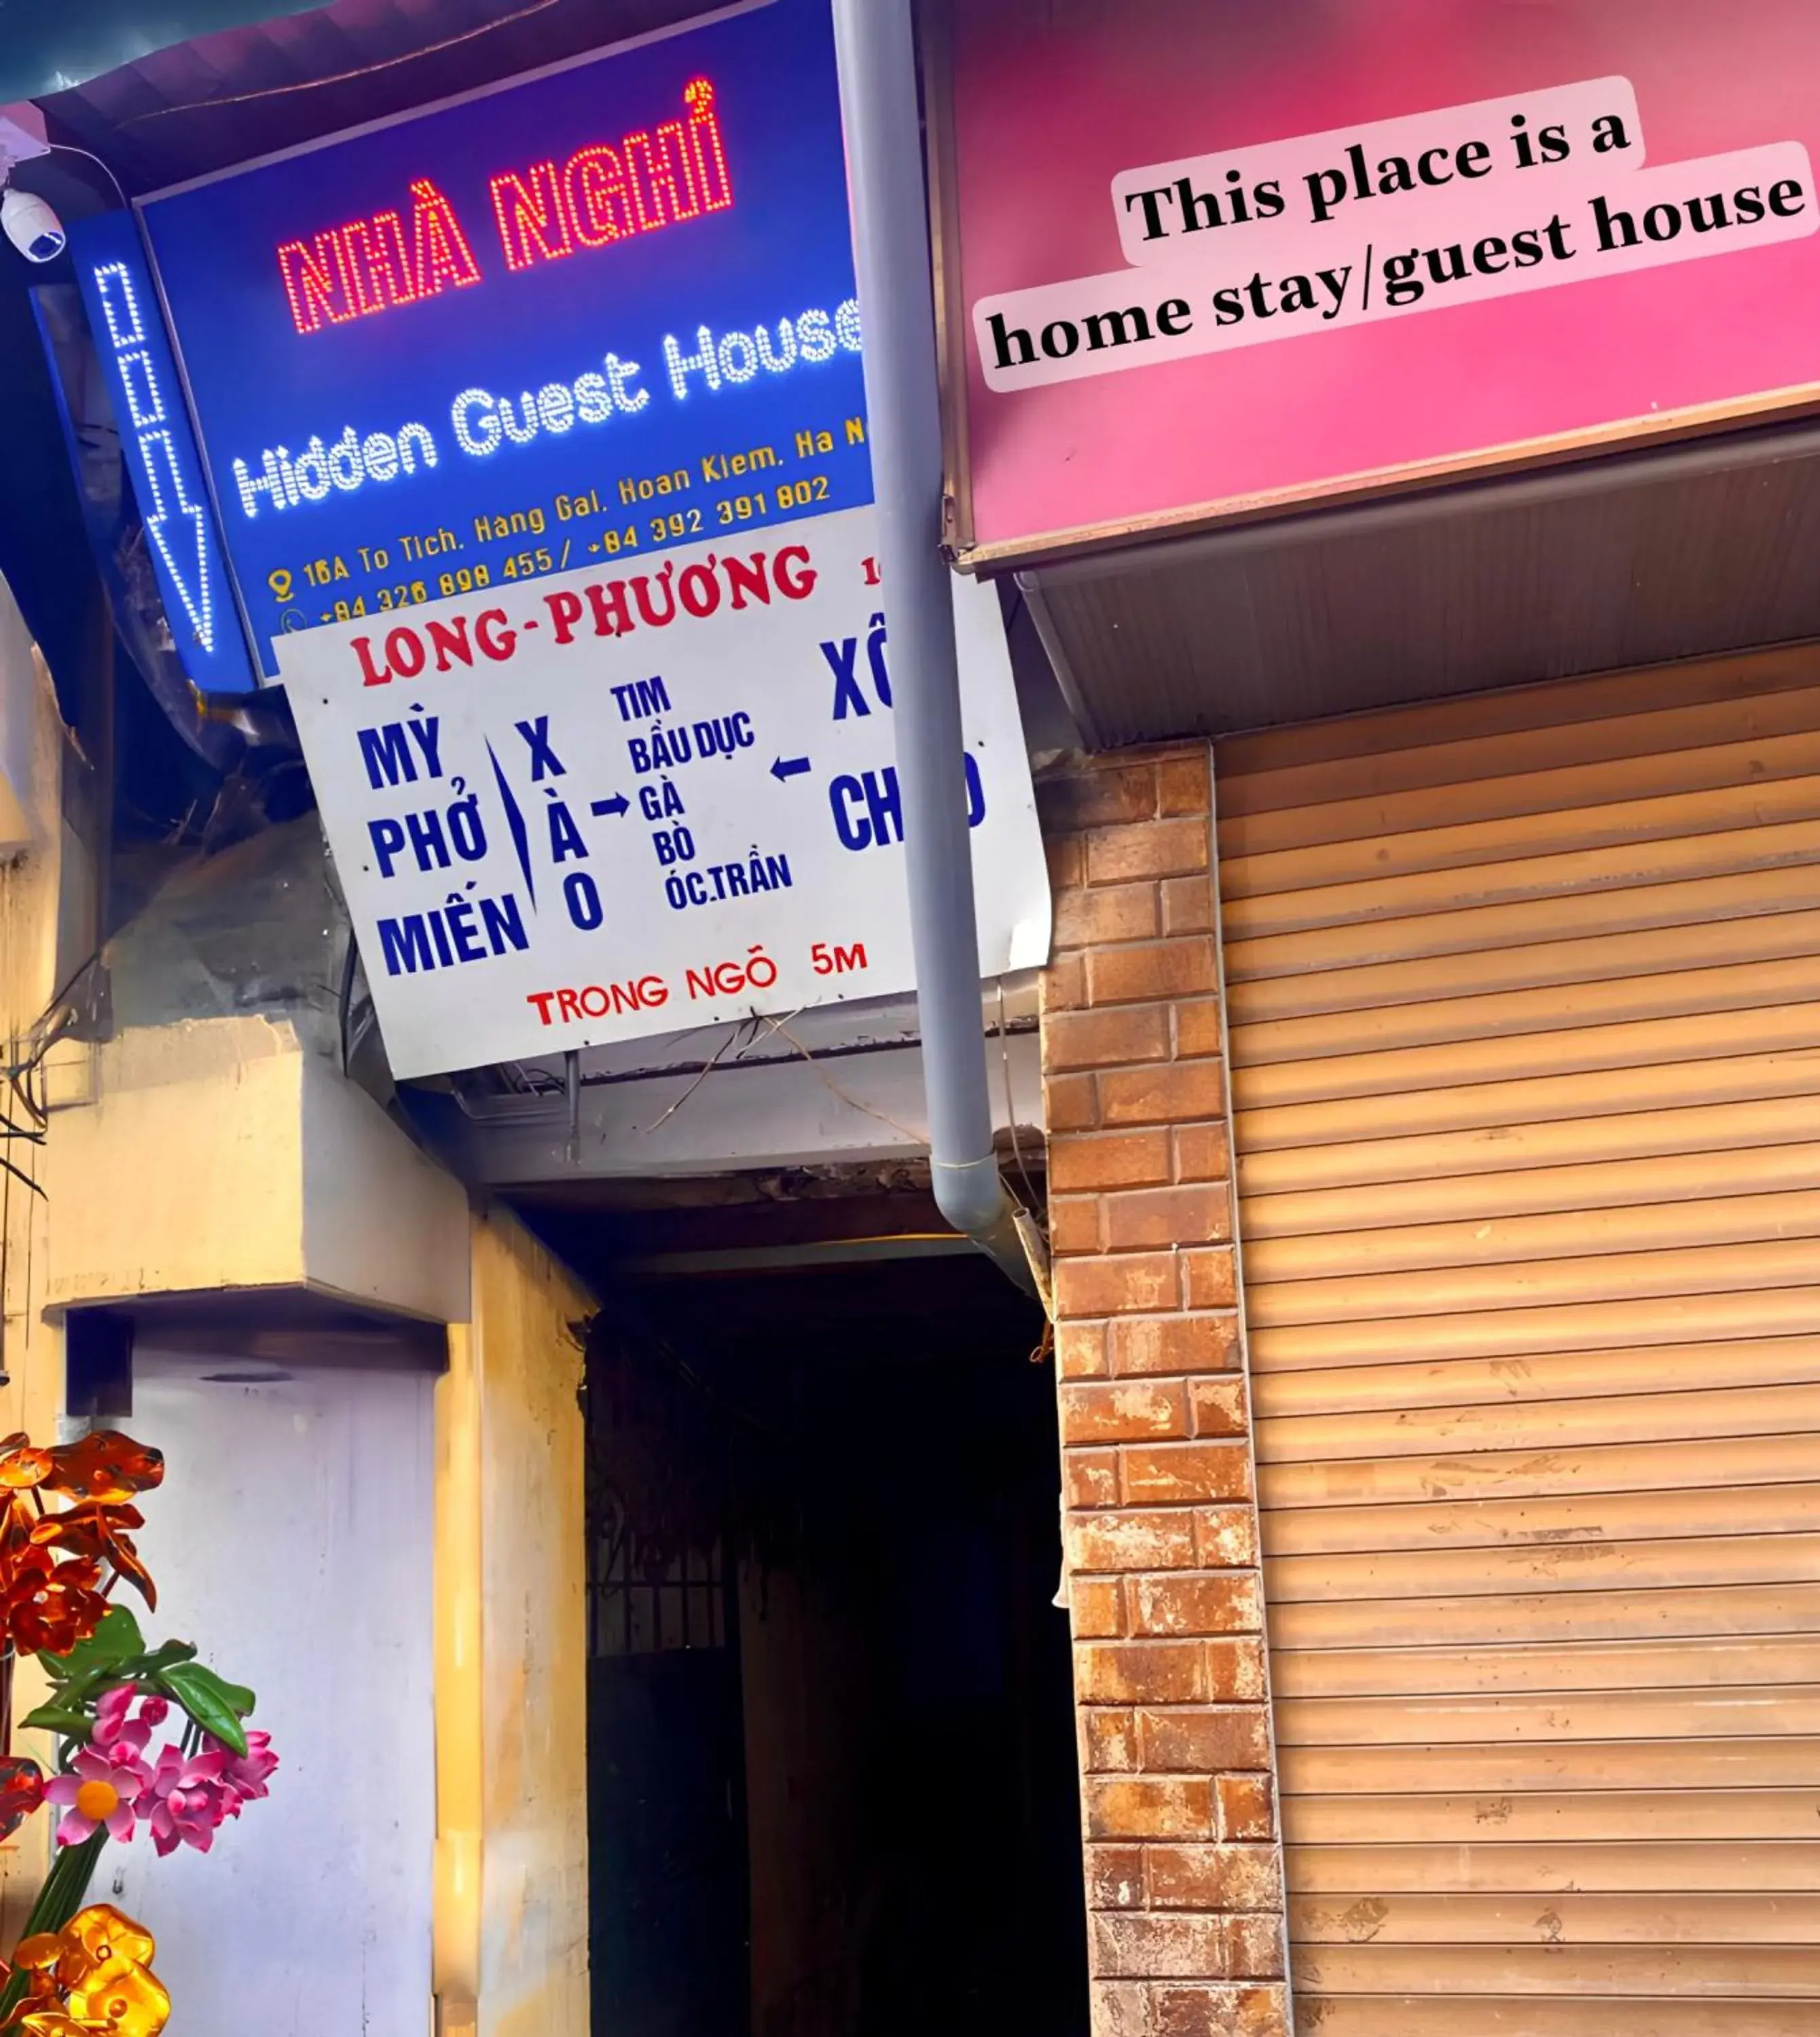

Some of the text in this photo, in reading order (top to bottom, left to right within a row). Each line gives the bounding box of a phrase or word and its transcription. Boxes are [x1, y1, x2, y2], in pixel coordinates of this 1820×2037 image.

[278, 77, 733, 334] NHÀ NGHỈ
[232, 297, 864, 519] Hidden Guest House
[304, 555, 350, 587] 16A
[357, 547, 390, 574] To
[617, 469, 691, 505] Hoan
[794, 429, 835, 459] Ha
[844, 416, 869, 446] N
[376, 579, 429, 613] 326
[438, 564, 491, 598] 898
[587, 525, 638, 555] +84
[649, 509, 704, 543] 392
[715, 492, 767, 525] 391
[775, 475, 831, 511] 802
[860, 555, 881, 585] 1
[610, 676, 672, 722] TIM
[627, 711, 755, 774] BẦU DỤC
[357, 702, 443, 790] MỲ
[367, 776, 489, 879] PHỞ
[638, 774, 685, 821] GÀ
[652, 820, 696, 866] BÒ
[376, 881, 530, 976] MIẾN
[526, 942, 869, 1027] TRONG NGÕ 5M
